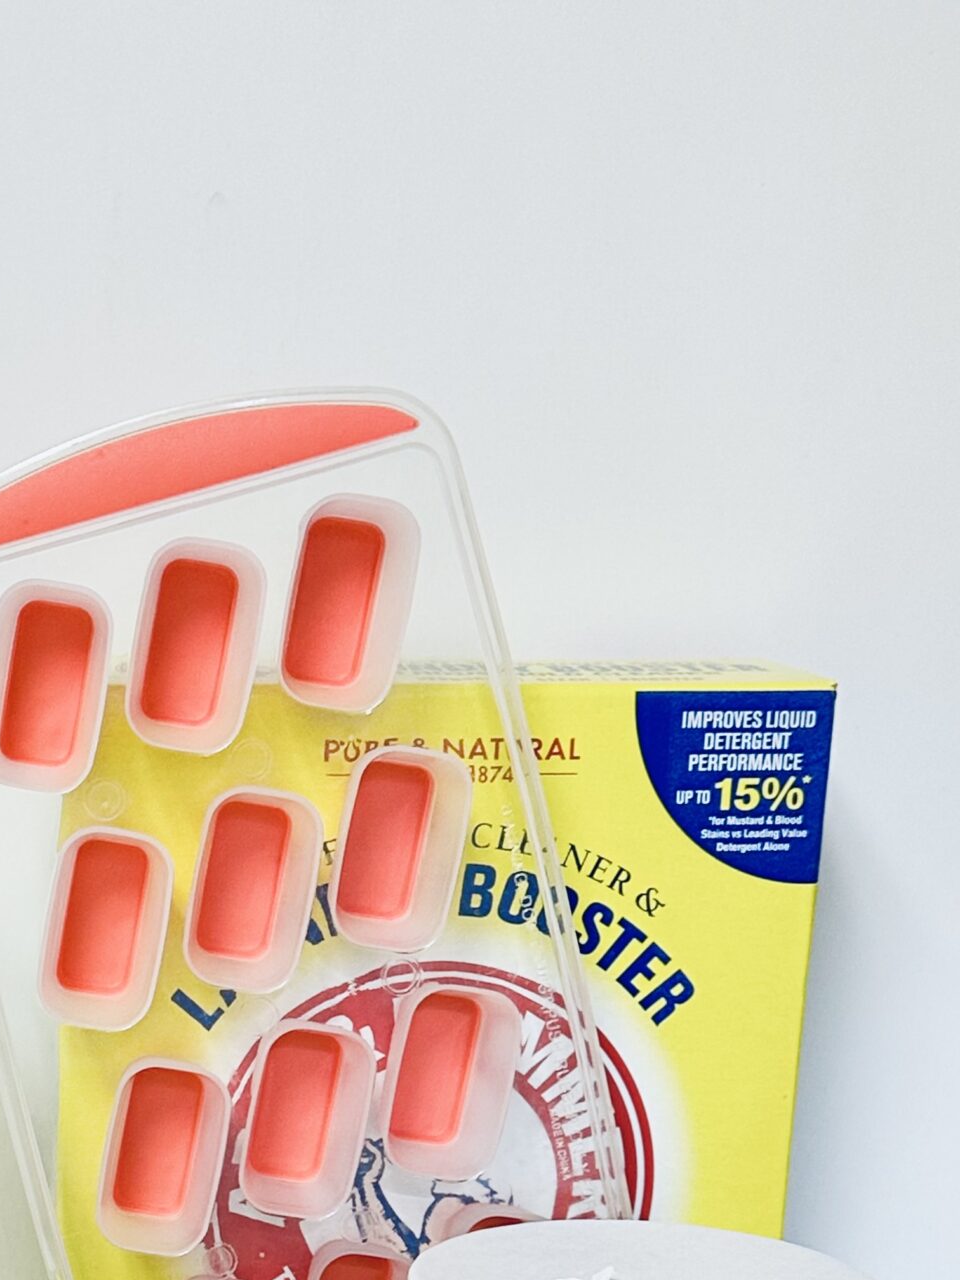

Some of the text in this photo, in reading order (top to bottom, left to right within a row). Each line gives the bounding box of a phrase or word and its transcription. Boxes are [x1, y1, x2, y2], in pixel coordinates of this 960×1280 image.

[681, 710, 817, 729] IMPROVES LIQUID
[442, 737, 581, 761] NATRAL
[703, 732, 793, 750] DETERGENT
[688, 753, 804, 772] PERFORMANCE
[675, 790, 694, 804] UP
[695, 790, 711, 804] TO
[727, 815, 764, 825] Mustard
[766, 815, 773, 825] &
[775, 815, 803, 825] Blood
[700, 829, 808, 840] Stains vs Leading Value
[716, 842, 790, 853] Detergent Alone
[471, 822, 632, 896] CLENER
[635, 887, 666, 918] &
[458, 863, 695, 1027] BOOSTER
